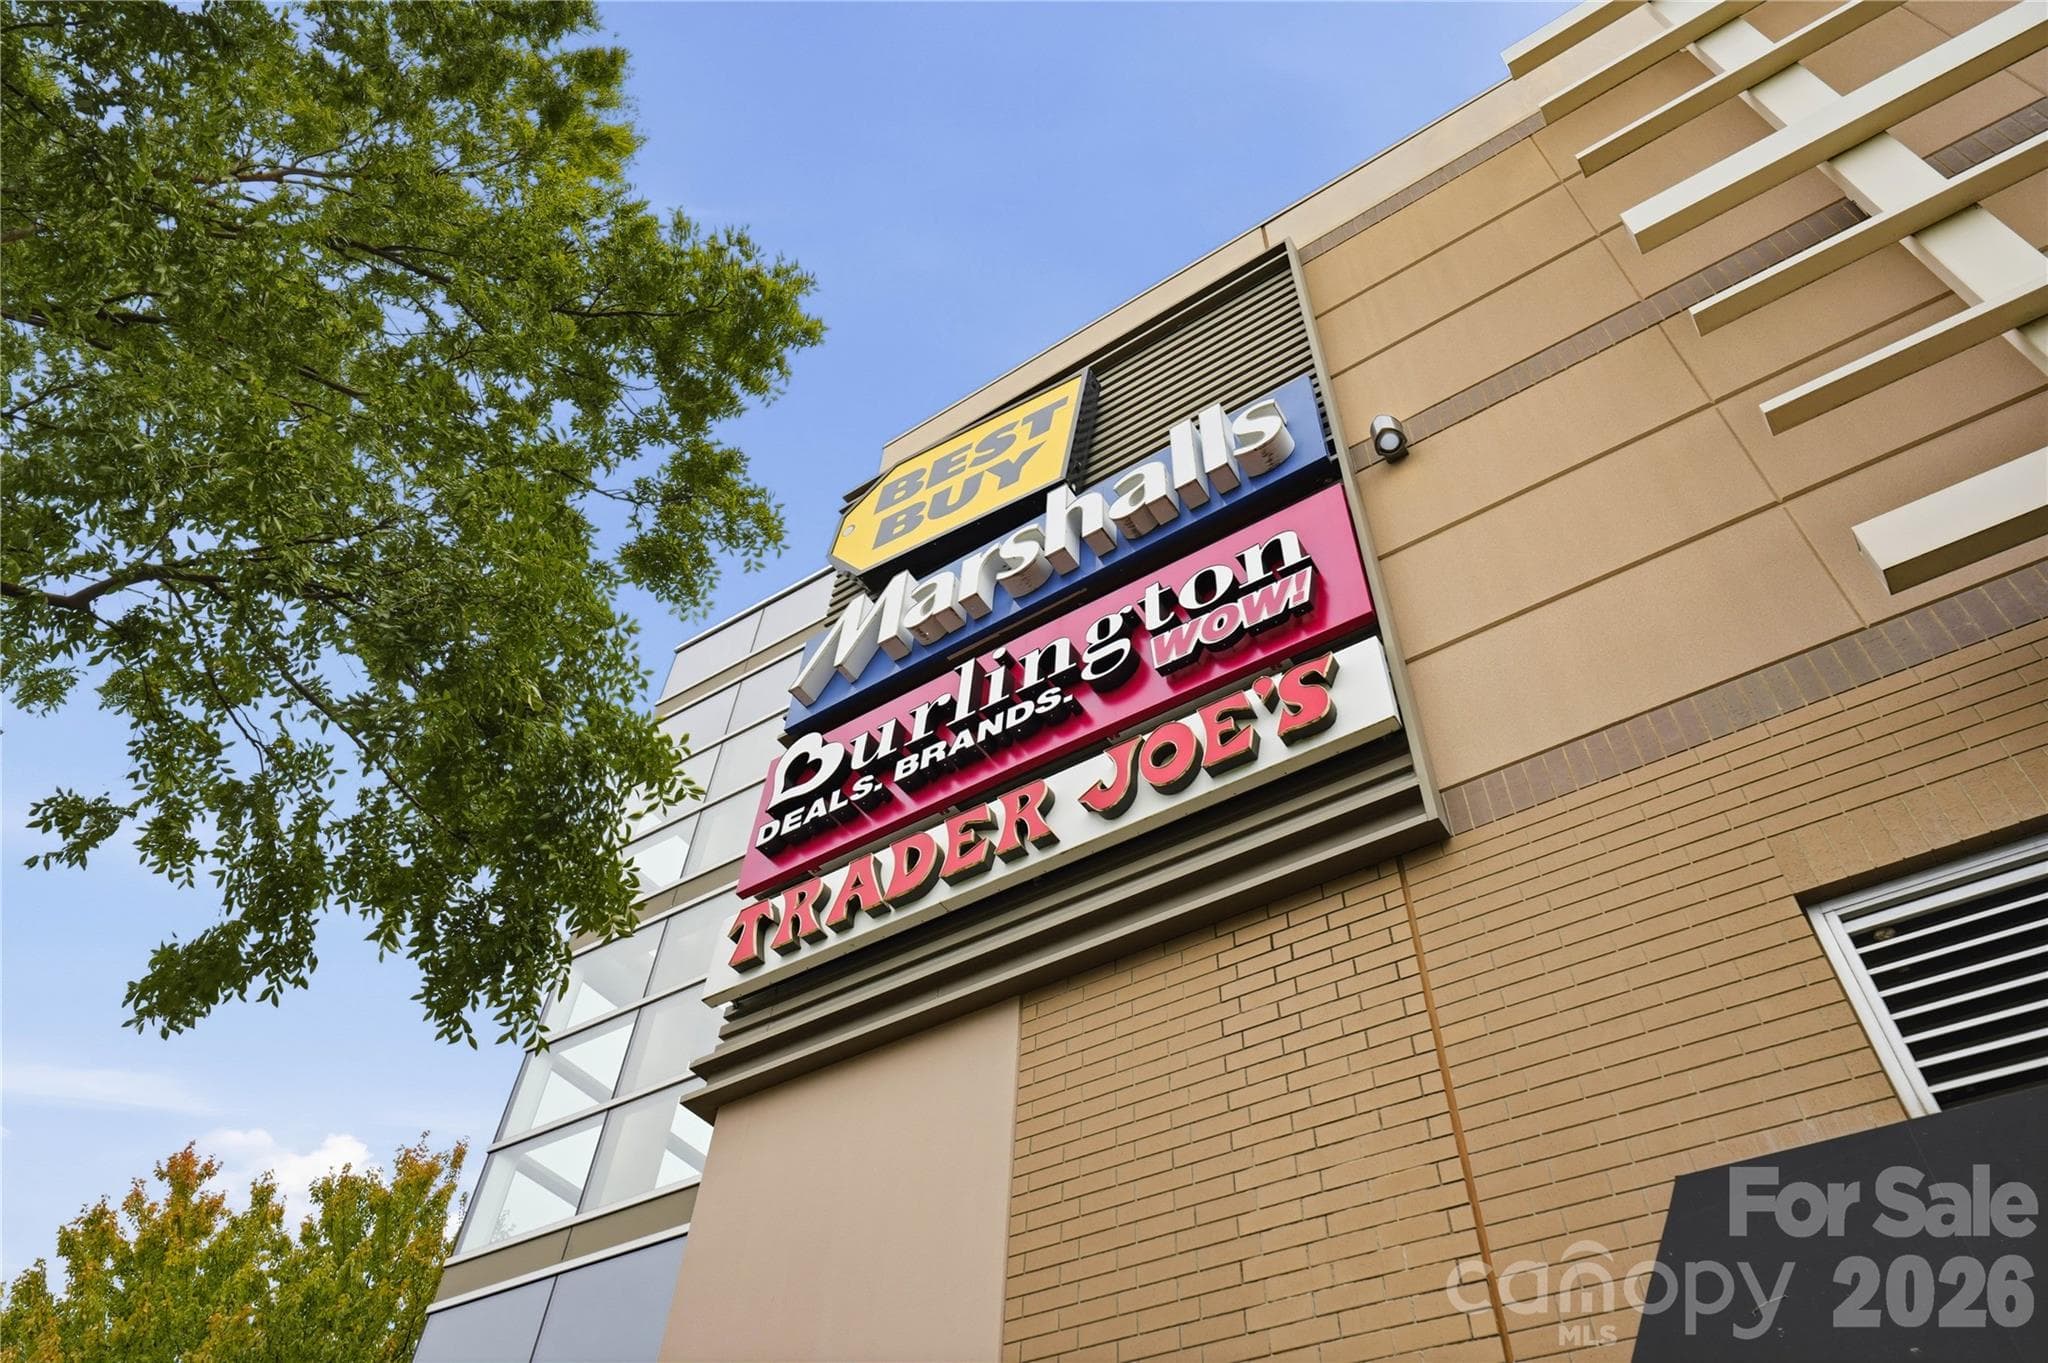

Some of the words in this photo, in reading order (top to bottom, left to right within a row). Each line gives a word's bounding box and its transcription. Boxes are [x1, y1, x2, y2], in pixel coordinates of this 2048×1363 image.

[791, 398, 1290, 702] Marshalls
[873, 441, 1047, 549] BUY
[874, 396, 1070, 514] BEST
[755, 781, 883, 849] DEALS.
[893, 685, 1074, 783] BRANDS.
[1150, 565, 1314, 674] WOW!
[766, 529, 1311, 810] Burlington
[727, 779, 1060, 974] TRADER
[1078, 652, 1340, 820] JOE'S
